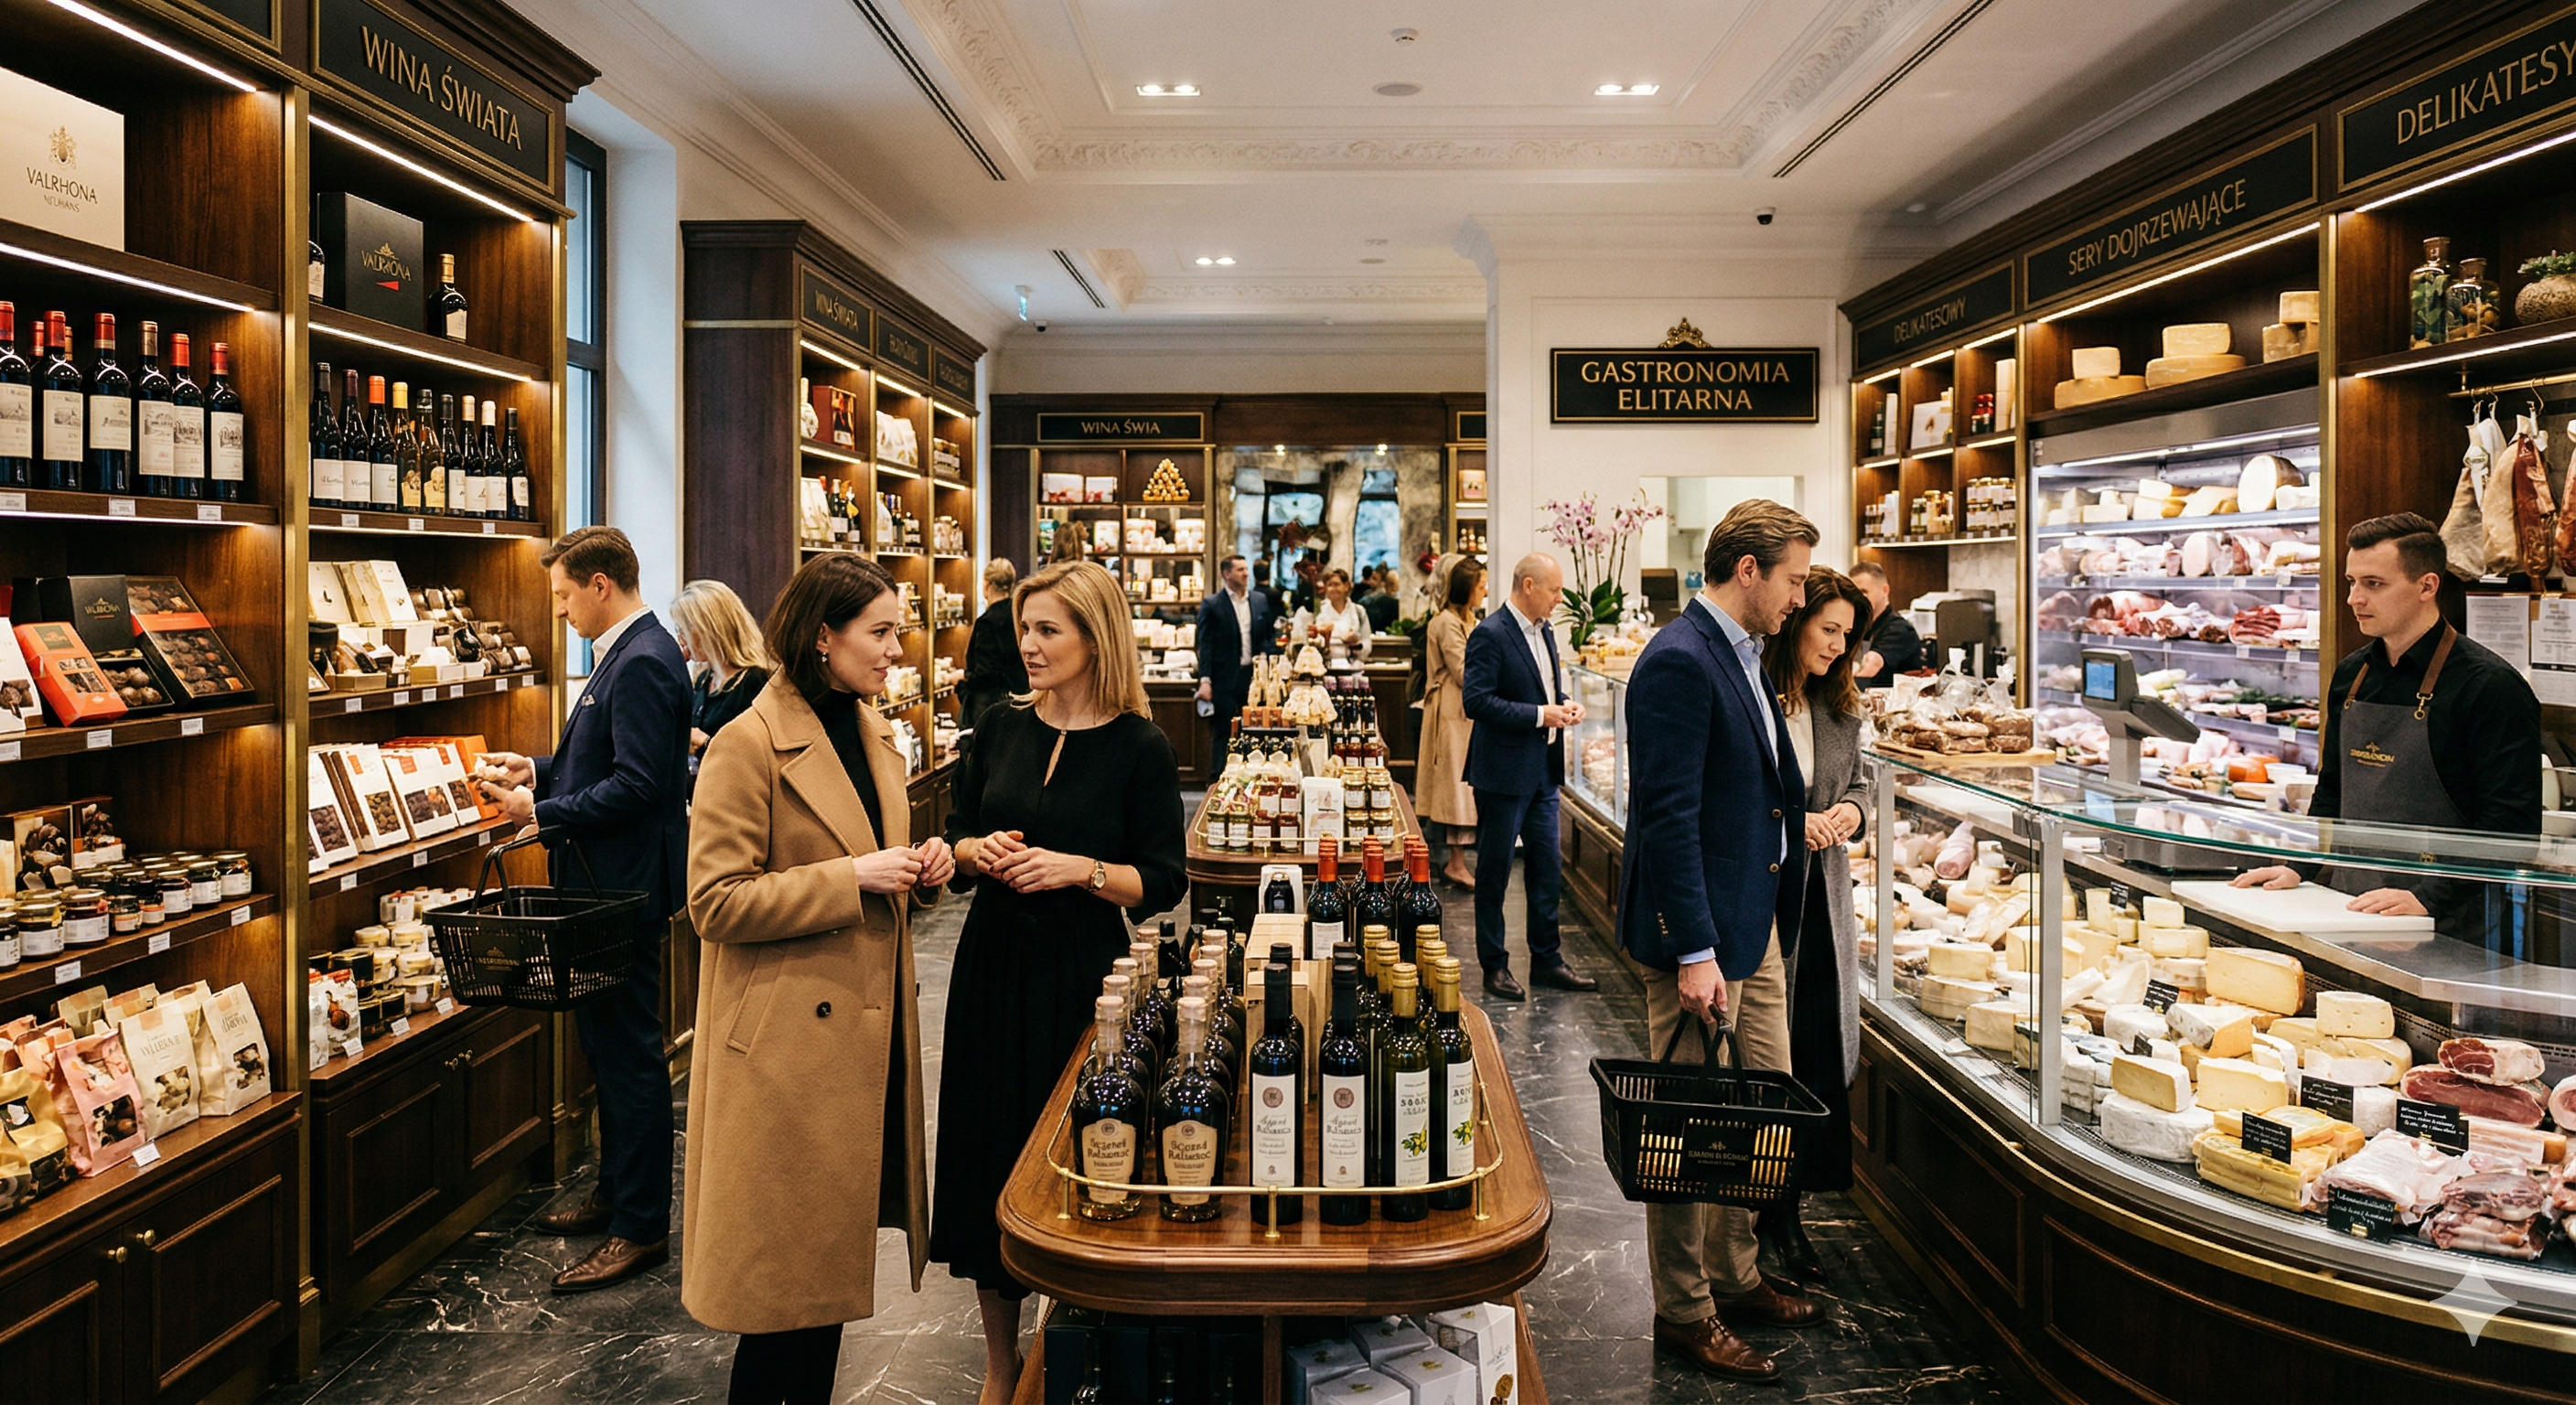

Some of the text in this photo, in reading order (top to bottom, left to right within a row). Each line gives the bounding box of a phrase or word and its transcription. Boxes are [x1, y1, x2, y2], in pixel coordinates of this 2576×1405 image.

[361, 25, 522, 151] WINA ŚWIATA
[2397, 39, 2576, 145] DELIKATESY
[27, 166, 98, 205] VALRHONA
[2068, 178, 2247, 276] SERY DOJRZEWAJĄCE
[1581, 361, 1790, 383] GASTRONOMIA
[1617, 389, 1753, 411] ELITARNA
[1081, 418, 1161, 434] WINA ŚWIA
